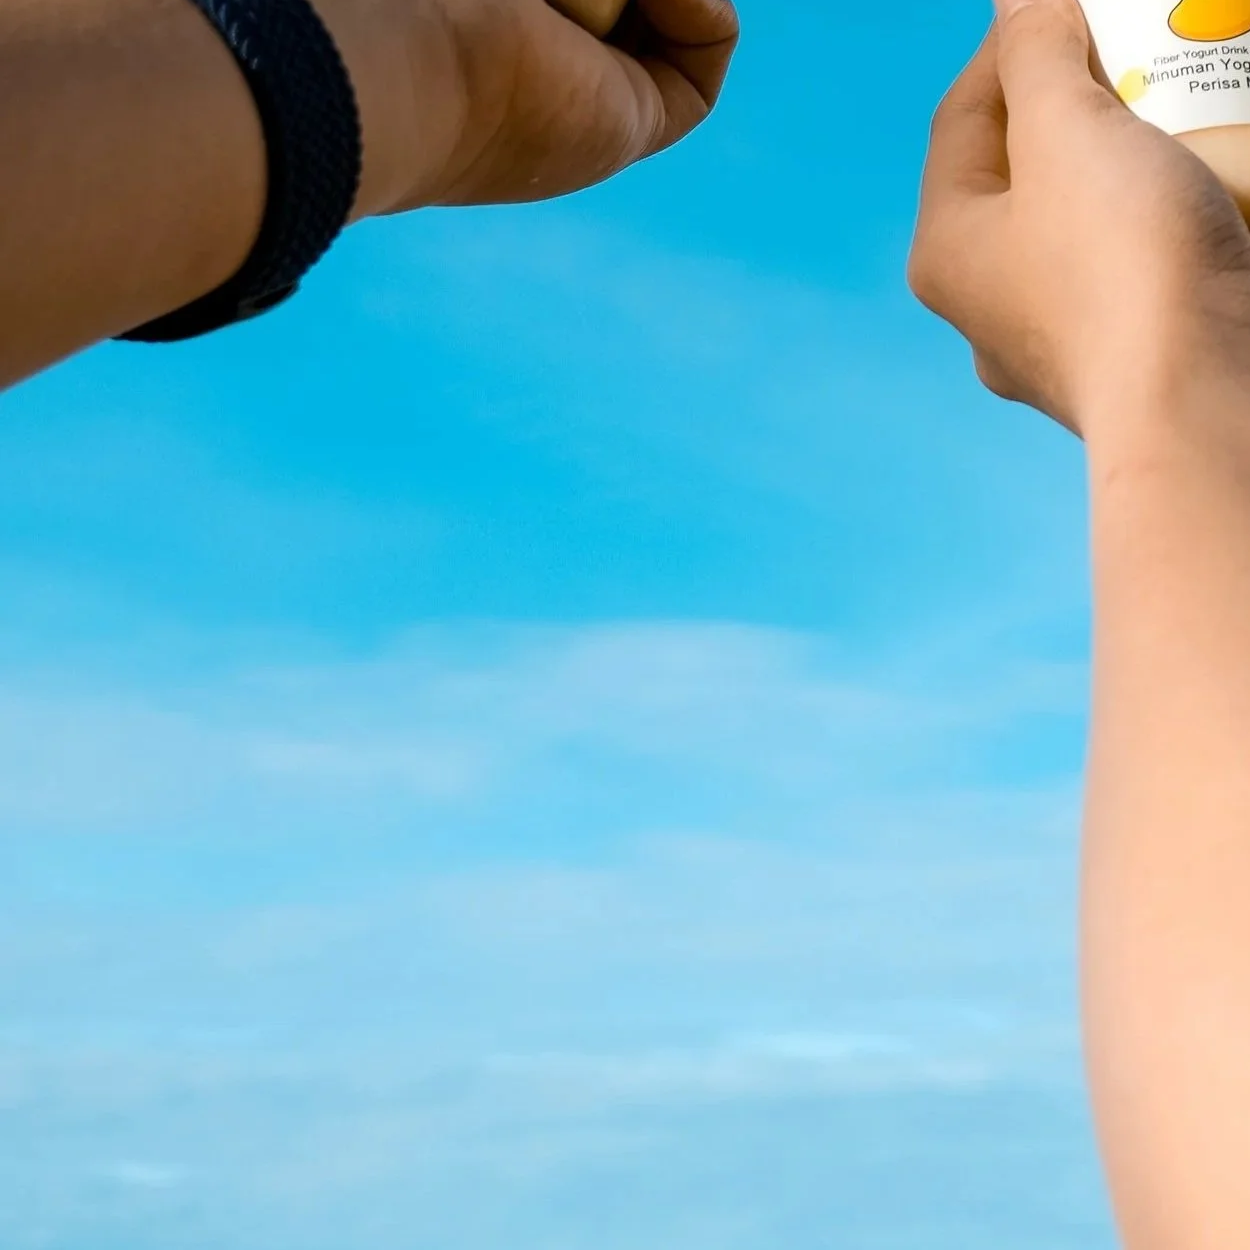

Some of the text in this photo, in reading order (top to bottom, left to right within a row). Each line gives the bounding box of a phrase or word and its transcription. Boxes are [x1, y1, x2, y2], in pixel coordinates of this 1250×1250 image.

[1153, 53, 1180, 67] Fiber
[1182, 47, 1218, 60] Yogurt
[1221, 45, 1248, 55] Drink
[1143, 61, 1215, 87] Minuman
[1188, 78, 1240, 93] Perisa
